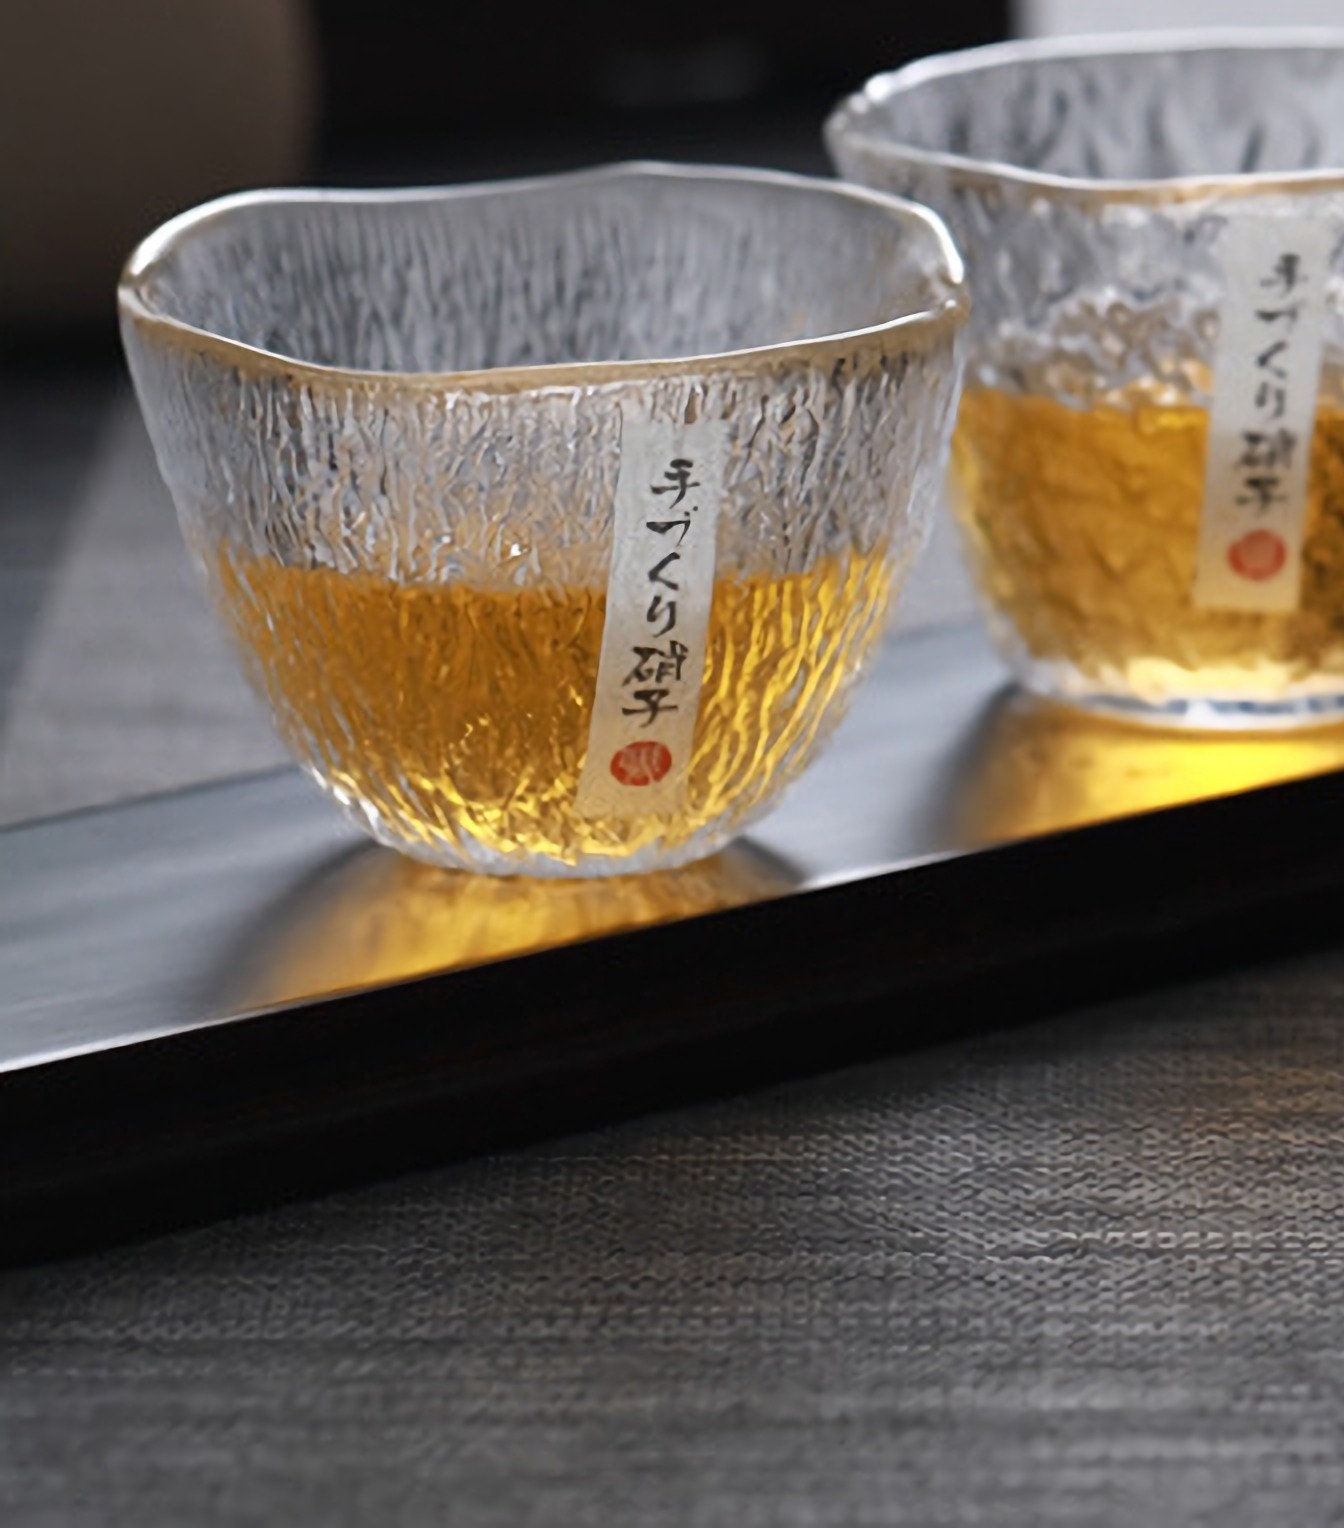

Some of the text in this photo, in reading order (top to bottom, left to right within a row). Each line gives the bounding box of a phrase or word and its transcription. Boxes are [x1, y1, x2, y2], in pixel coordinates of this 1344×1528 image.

[622, 458, 700, 727] 手づくり硝子
